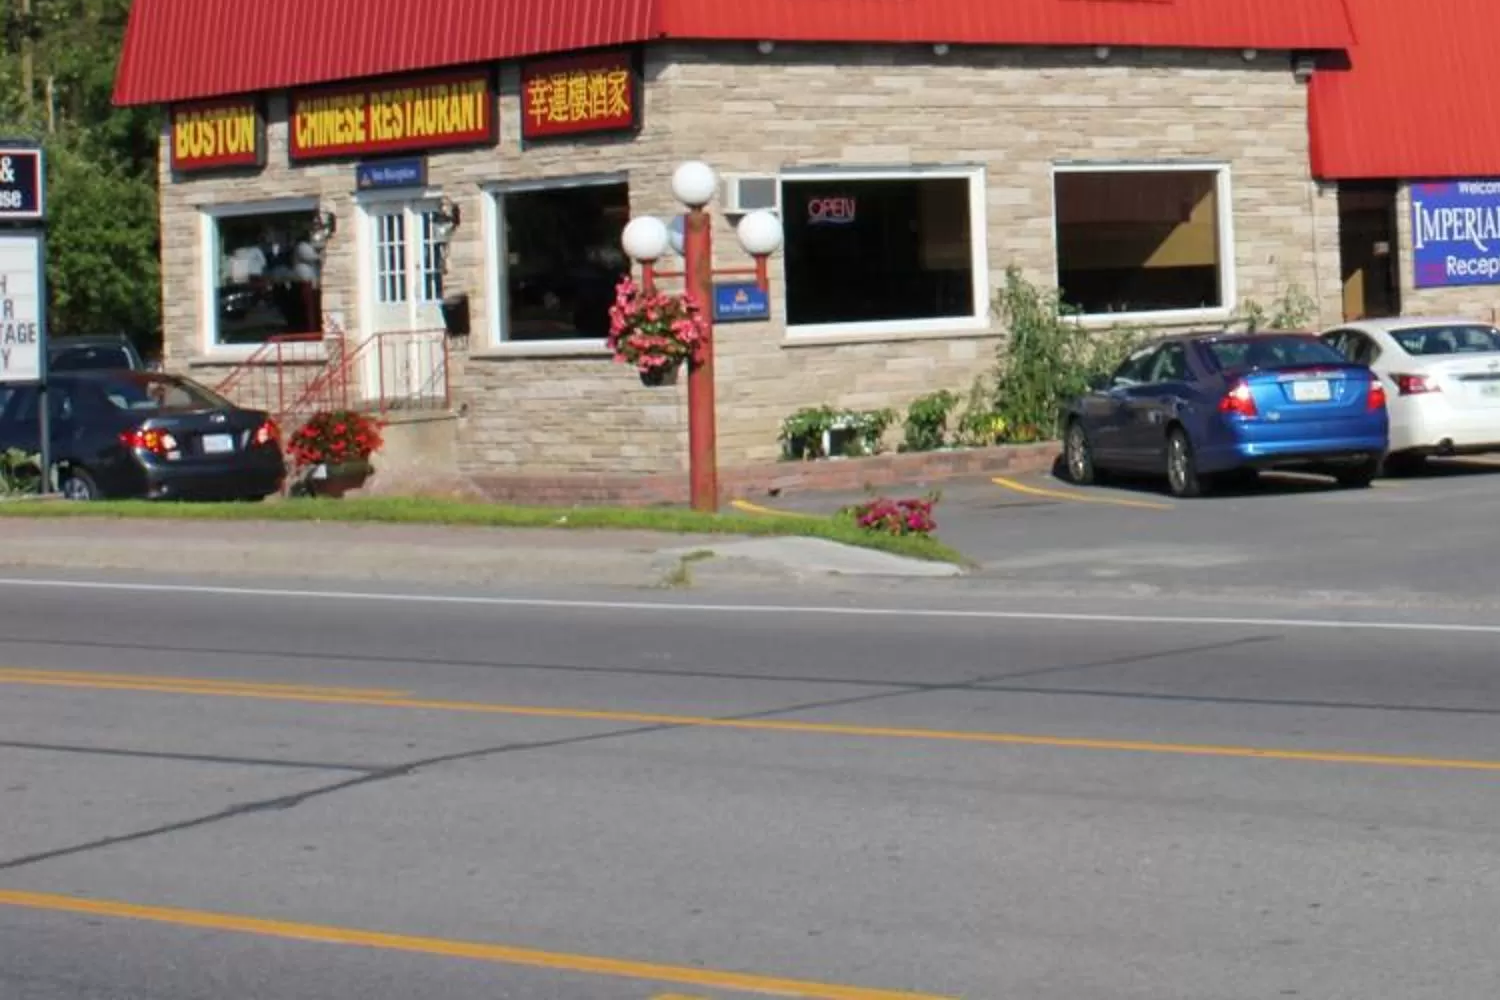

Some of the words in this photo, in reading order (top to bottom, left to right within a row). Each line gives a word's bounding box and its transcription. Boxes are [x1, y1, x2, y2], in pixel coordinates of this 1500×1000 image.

[176, 105, 255, 159] BOSTON
[296, 92, 366, 148] CHINESE
[370, 78, 486, 141] RESTAURANT
[808, 197, 856, 217] OPEN
